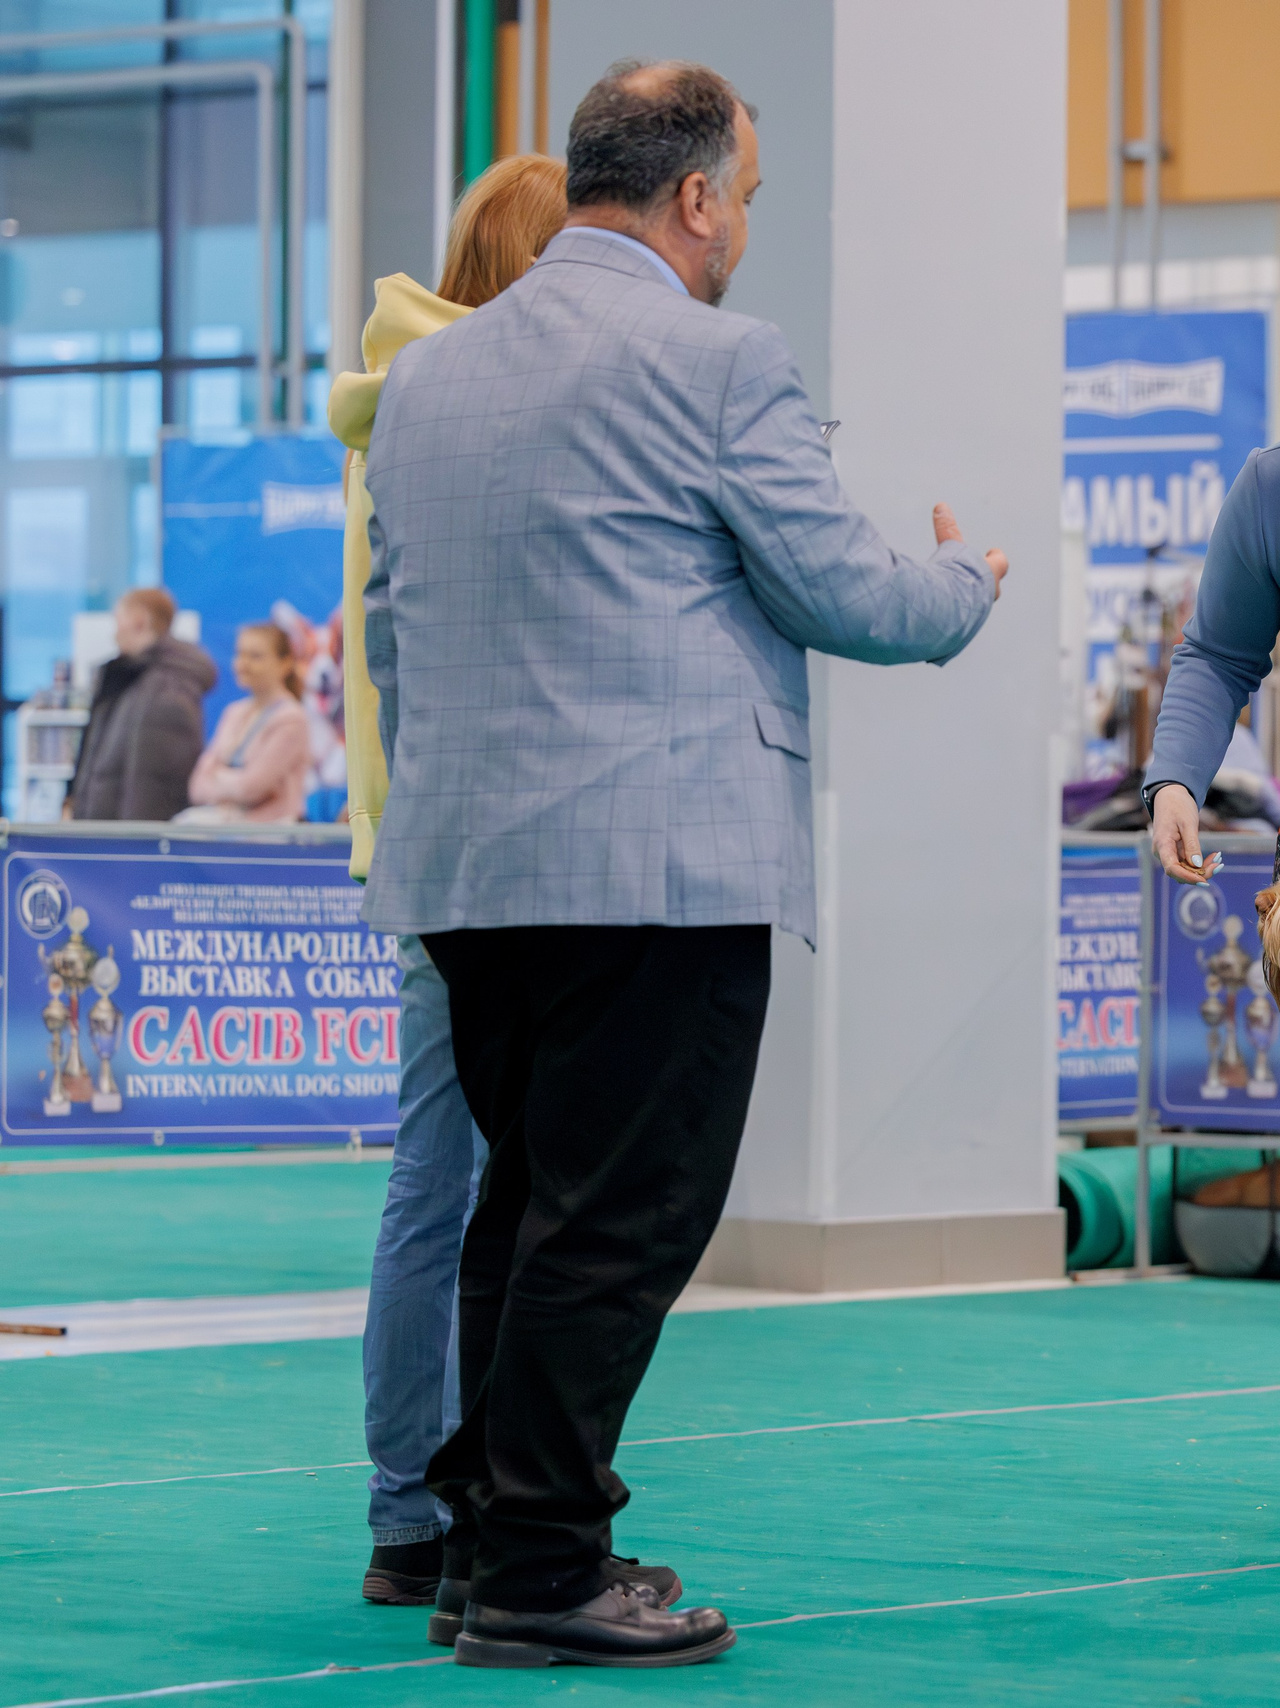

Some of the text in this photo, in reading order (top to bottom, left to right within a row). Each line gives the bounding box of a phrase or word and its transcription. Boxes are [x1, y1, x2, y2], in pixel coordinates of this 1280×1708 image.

[1062, 461, 1225, 547] АМЫЙ
[130, 930, 398, 966] МЕЖДУНАРОДНАЯ
[139, 964, 398, 998] ВЫСТАВКА СОБАК
[128, 1005, 401, 1067] CACIB FCI
[126, 1073, 400, 1098] INTERNATIONAL DOG SHOW
